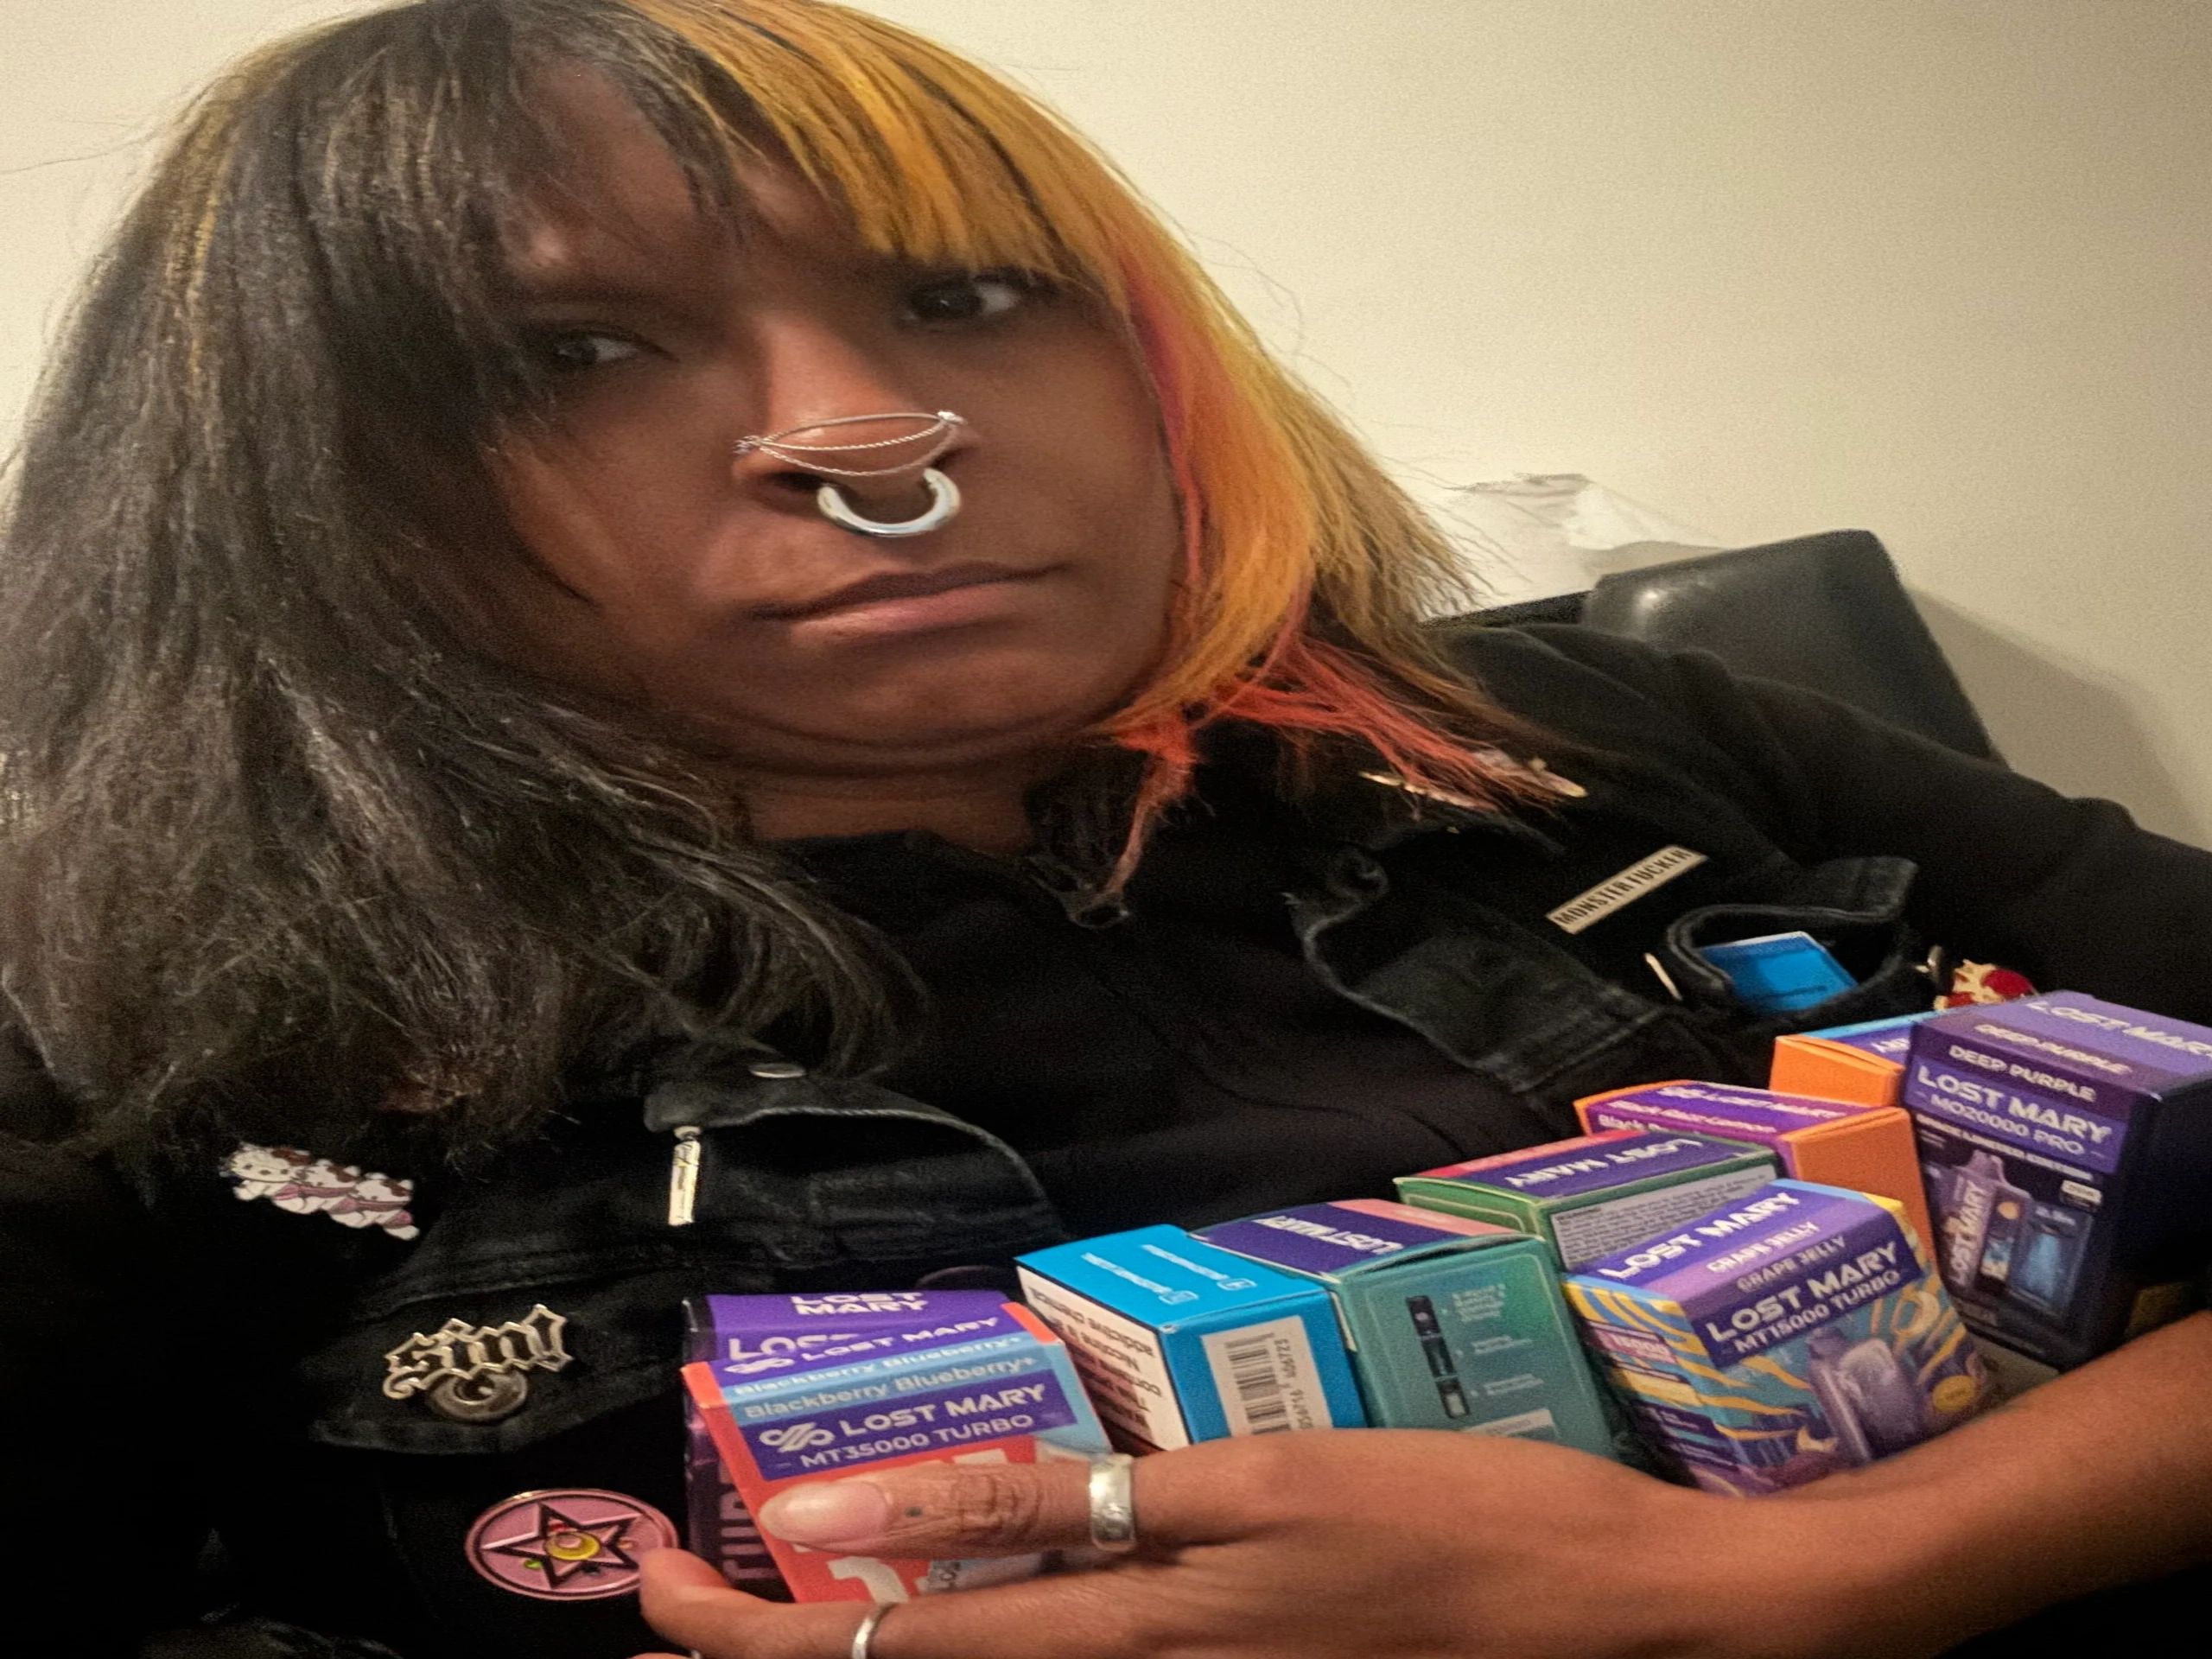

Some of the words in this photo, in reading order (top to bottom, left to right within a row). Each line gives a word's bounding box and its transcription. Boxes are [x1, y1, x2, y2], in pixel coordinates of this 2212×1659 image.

[2025, 1000, 2132, 1031] LOST
[2122, 1026, 2212, 1058] MAR
[1948, 1044, 2007, 1072] DEEP
[2009, 1064, 2097, 1102] PURPLE
[1917, 1065, 2005, 1109] LOST
[2007, 1096, 2113, 1144] MARY
[1929, 1093, 2030, 1137] MO20000
[2032, 1128, 2084, 1155] PRO
[1598, 1233, 1703, 1280] LOST
[1694, 1192, 1800, 1238] MARY
[1737, 1261, 1798, 1292] GRAPE
[1800, 1235, 1847, 1267] JELLY
[791, 1293, 924, 1306] LOST
[795, 1300, 930, 1315] MARY
[1705, 1284, 1802, 1342] LOST
[1806, 1241, 1898, 1300] MARY
[1735, 1303, 1830, 1354] MT15000
[1830, 1270, 1901, 1311] TURBO
[801, 1336, 894, 1362] LOST
[902, 1316, 999, 1343] MARY
[734, 1361, 875, 1396] Blackberry
[745, 1382, 889, 1418] Blackberry
[839, 1403, 937, 1438] LOST
[944, 1382, 1046, 1419] MARY
[799, 1433, 931, 1468] MT35000
[931, 1414, 1034, 1440] TURBO
